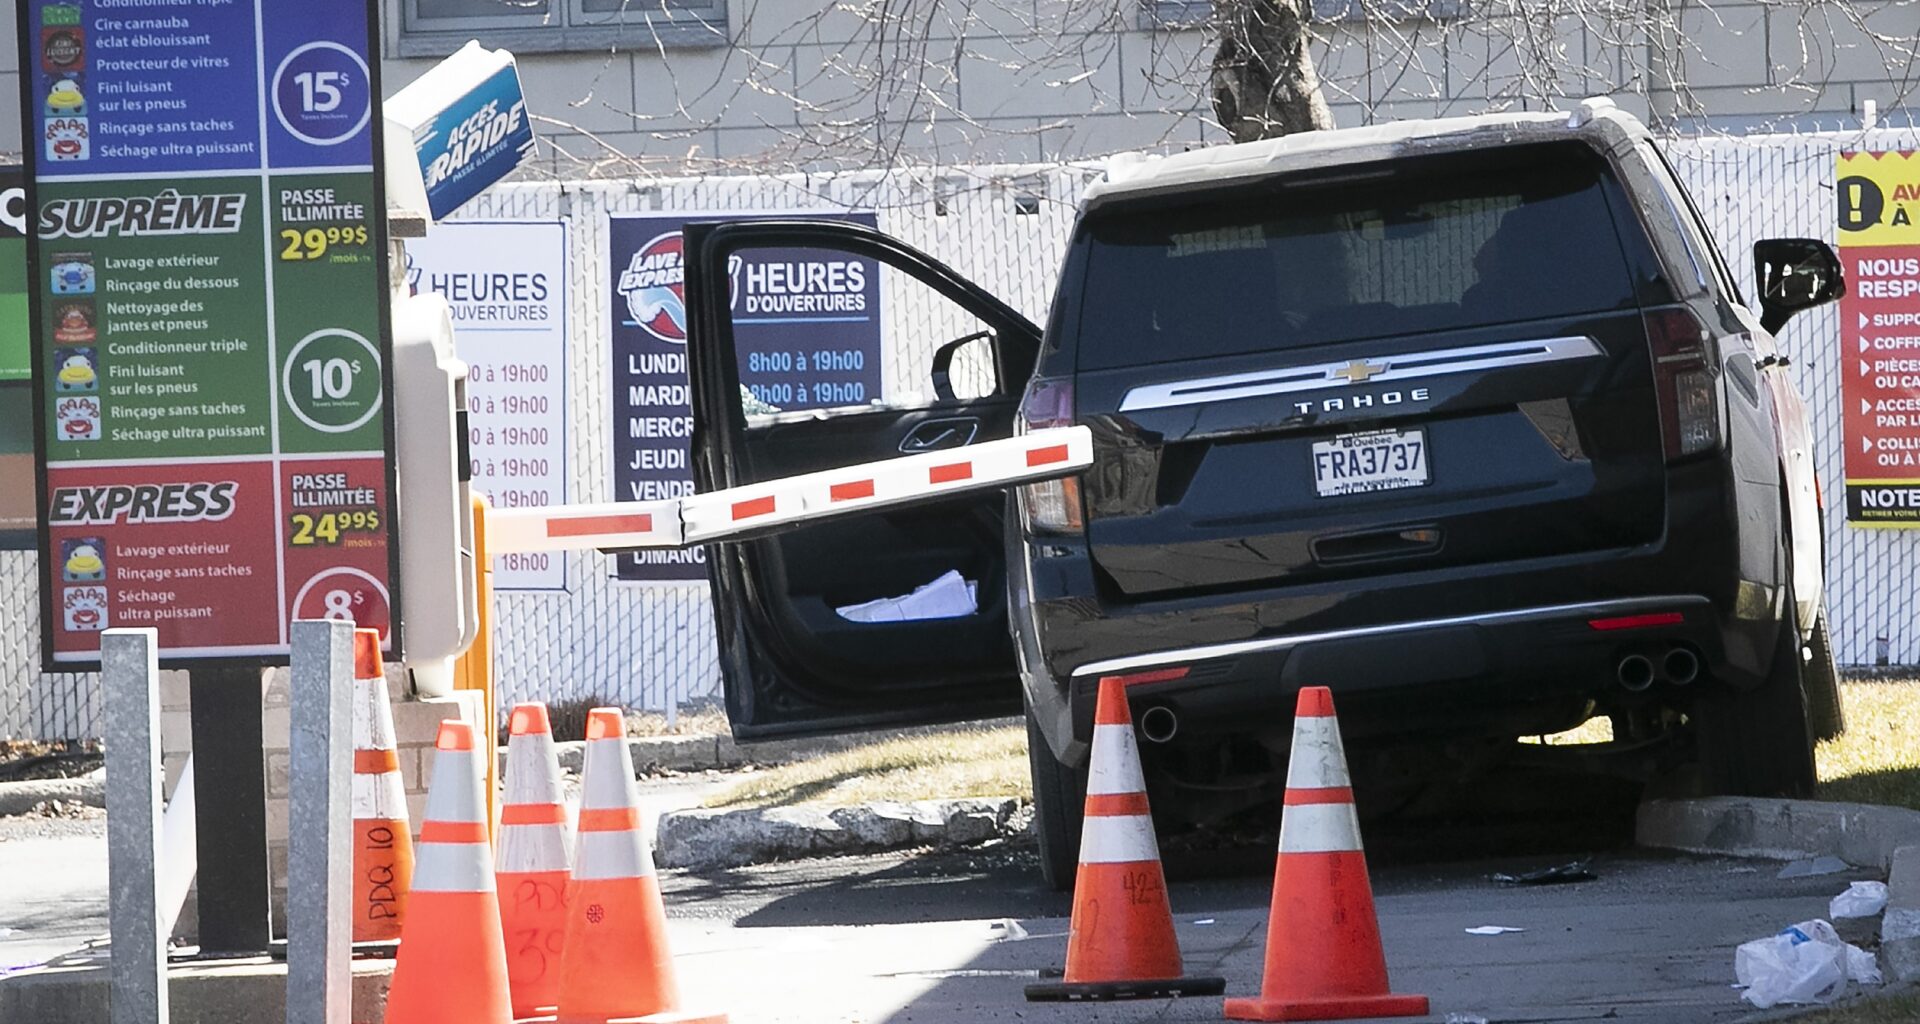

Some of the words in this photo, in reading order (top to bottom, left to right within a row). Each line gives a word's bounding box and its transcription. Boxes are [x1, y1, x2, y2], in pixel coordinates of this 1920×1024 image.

[95, 18, 122, 31] Cire
[125, 16, 189, 30] carnauba
[96, 35, 128, 48] éclat
[131, 33, 210, 47] éblouissant
[97, 58, 168, 71] Protecteur
[171, 56, 188, 69] de
[190, 56, 230, 69] vitres
[98, 81, 123, 94] Fini
[126, 81, 173, 93] luisant
[99, 101, 119, 111] sur
[123, 98, 141, 110] les
[145, 99, 187, 112] pneus
[99, 122, 154, 136] Rinçage
[157, 121, 187, 133] sans
[190, 118, 234, 131] taches
[101, 144, 158, 159] Séchage
[160, 142, 194, 155] ultra
[196, 141, 254, 156] puissant
[427, 100, 523, 188] RAPIDE
[281, 188, 335, 205] PASSE
[38, 188, 246, 239] SUPRÊME
[282, 201, 364, 221] ILLIMITÉE
[1891, 203, 1911, 226] À
[105, 257, 154, 271] Lavage
[157, 254, 220, 267] extérieur
[634, 252, 678, 272] LAVE
[1858, 259, 1919, 276] NOUS
[106, 279, 161, 294] Rinçage
[163, 277, 181, 290] du
[184, 276, 239, 289] dessous
[747, 261, 866, 294] HEURES
[432, 274, 547, 301] HEURES
[1859, 280, 1920, 297] RESP
[107, 302, 178, 316] Nettoyage
[180, 300, 204, 312] des
[746, 294, 866, 312] D'OUVERTURES
[107, 320, 149, 335] jantes
[151, 320, 165, 331] et
[167, 319, 208, 333] pneus
[108, 341, 208, 355] Conditionneur
[210, 339, 248, 354] triple
[629, 354, 684, 374] LUNDI
[749, 352, 791, 372] 8h00
[796, 351, 806, 371] à
[812, 350, 864, 371] 19h00
[109, 365, 134, 377] Fini
[137, 364, 185, 377] luisant
[486, 364, 494, 382] à
[501, 364, 548, 382] 19h00
[110, 385, 131, 395] sur
[134, 382, 153, 394] les
[157, 383, 198, 396] pneus
[1875, 376, 1897, 388] OU
[629, 385, 689, 406] MARDI
[797, 383, 807, 402] à
[813, 382, 865, 402] 19h00
[1294, 388, 1429, 414] TAHOE
[111, 405, 166, 420] Rinçage
[168, 405, 199, 416] sans
[202, 402, 246, 415] taches
[486, 395, 494, 413] à
[501, 395, 548, 413] 19h00
[1877, 415, 1906, 427] PAR
[112, 427, 169, 442] Séchage
[172, 426, 205, 438] ultra
[207, 425, 266, 440] puissant
[486, 427, 494, 445] à
[501, 427, 548, 445] 19h00
[1354, 436, 1392, 447] Québec
[486, 458, 495, 476] à
[502, 459, 548, 476] 19h00
[630, 449, 684, 469] JEUDI
[1315, 442, 1421, 480] FRA3737
[1878, 453, 1899, 466] OU
[1903, 451, 1914, 465] À
[293, 474, 346, 490] PASSE
[49, 482, 239, 526] EXPRESS
[294, 487, 375, 506] ILLIMITÉE
[502, 490, 549, 507] 19h00
[116, 545, 166, 559] Lavage
[168, 542, 230, 555] extérieur
[502, 553, 549, 571] 18h00
[117, 567, 172, 582] Rinçage
[174, 566, 205, 578] sans
[208, 564, 252, 577] taches
[118, 589, 176, 604] Séchage
[119, 607, 151, 620] ultra
[154, 606, 213, 621] puissant
[368, 864, 397, 920] PDQ
[513, 879, 570, 917] PD
